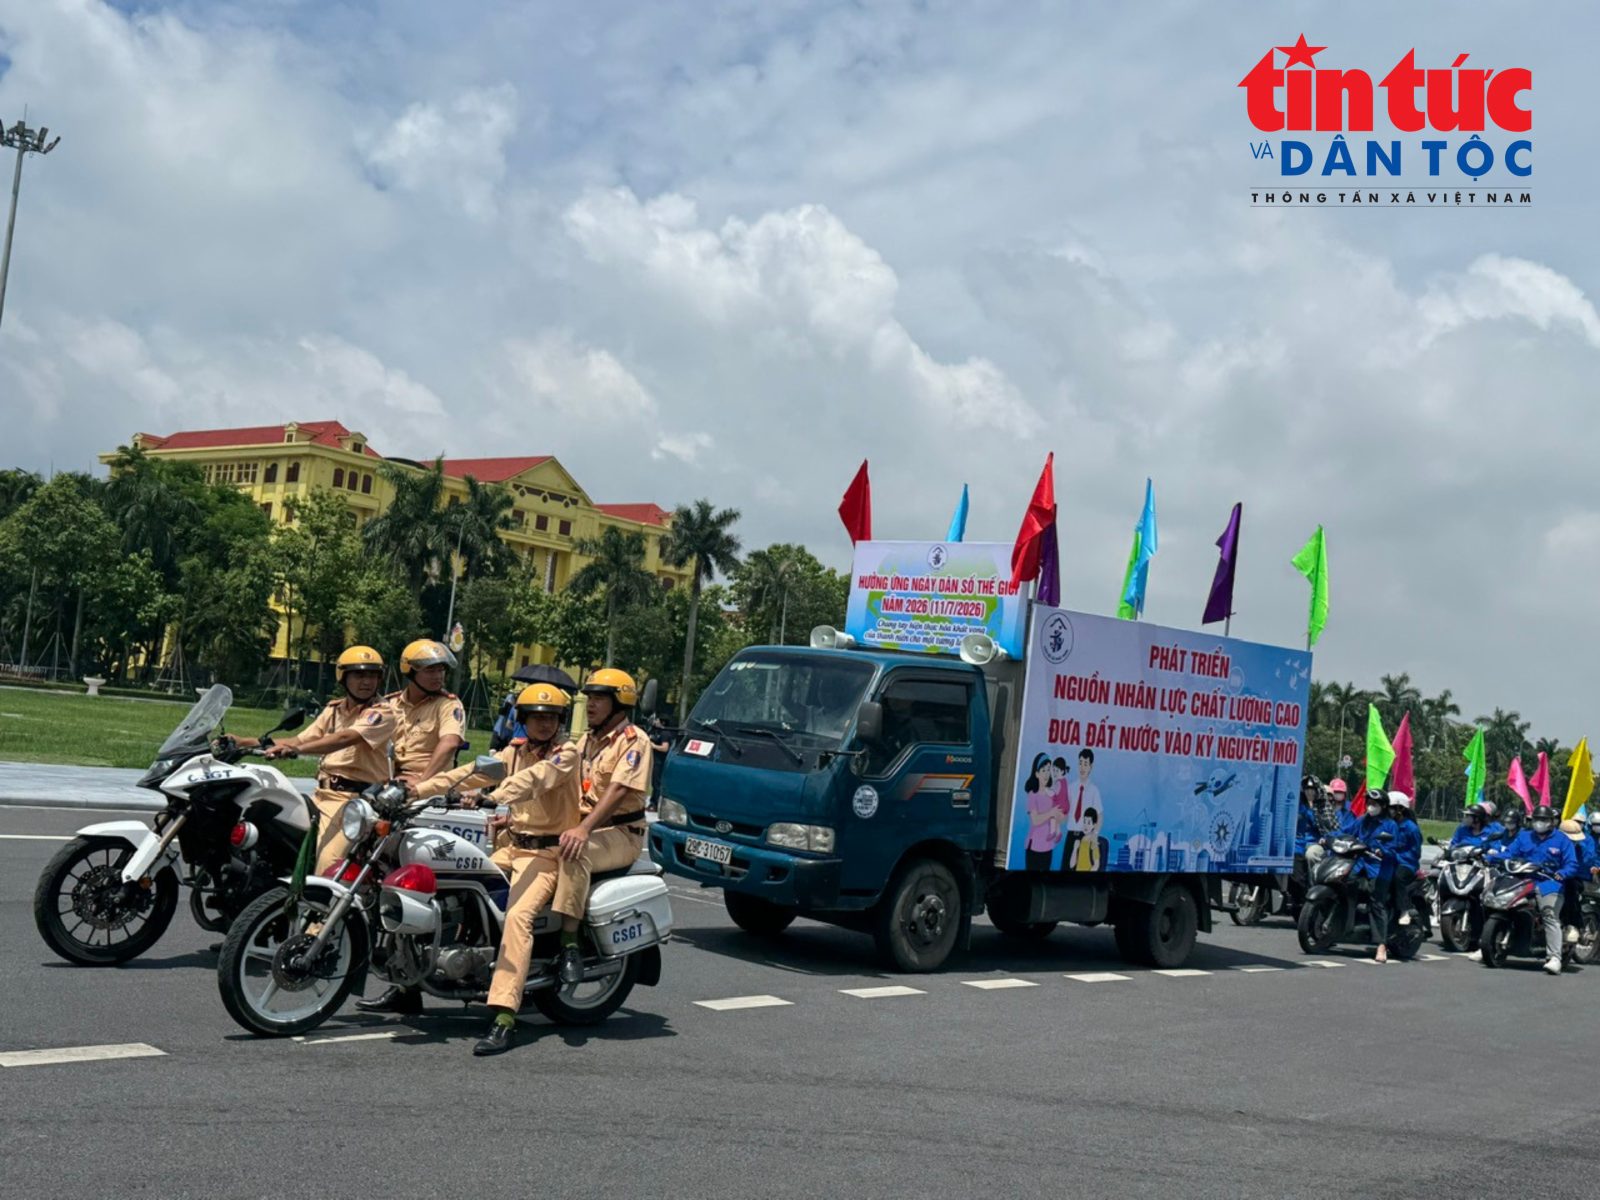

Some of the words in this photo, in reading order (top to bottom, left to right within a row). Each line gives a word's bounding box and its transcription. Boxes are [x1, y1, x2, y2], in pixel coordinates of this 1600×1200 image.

[858, 571, 889, 590] HƯỞNG
[890, 573, 910, 591] ỨNG
[911, 575, 937, 592] NGÀY
[938, 576, 959, 593] DÂN
[961, 575, 976, 594] SỐ
[977, 576, 997, 595] THẾ
[882, 595, 903, 612] NĂM
[905, 599, 928, 614] 2026
[930, 601, 985, 618] (11/7/2026)
[1149, 644, 1187, 673] PHÁT
[1191, 646, 1230, 679] TRIỂN
[1054, 670, 1110, 705] NGUỒN
[1114, 680, 1157, 710] NHÂN
[1160, 688, 1187, 719] LỰC
[1191, 687, 1227, 719] CHẤT
[1229, 696, 1272, 727] LƯỢNG
[1275, 702, 1300, 727] CAO
[1048, 718, 1080, 746] ĐƯA
[1085, 715, 1116, 749] ĐẤT
[1119, 724, 1161, 753] NƯỚC
[1165, 726, 1192, 756] VÀO
[1195, 727, 1214, 757] KỶ
[1217, 735, 1270, 762] NGUYÊN
[1273, 738, 1298, 765] MỚI
[456, 857, 484, 869] CSGT
[613, 923, 642, 944] CSGT
